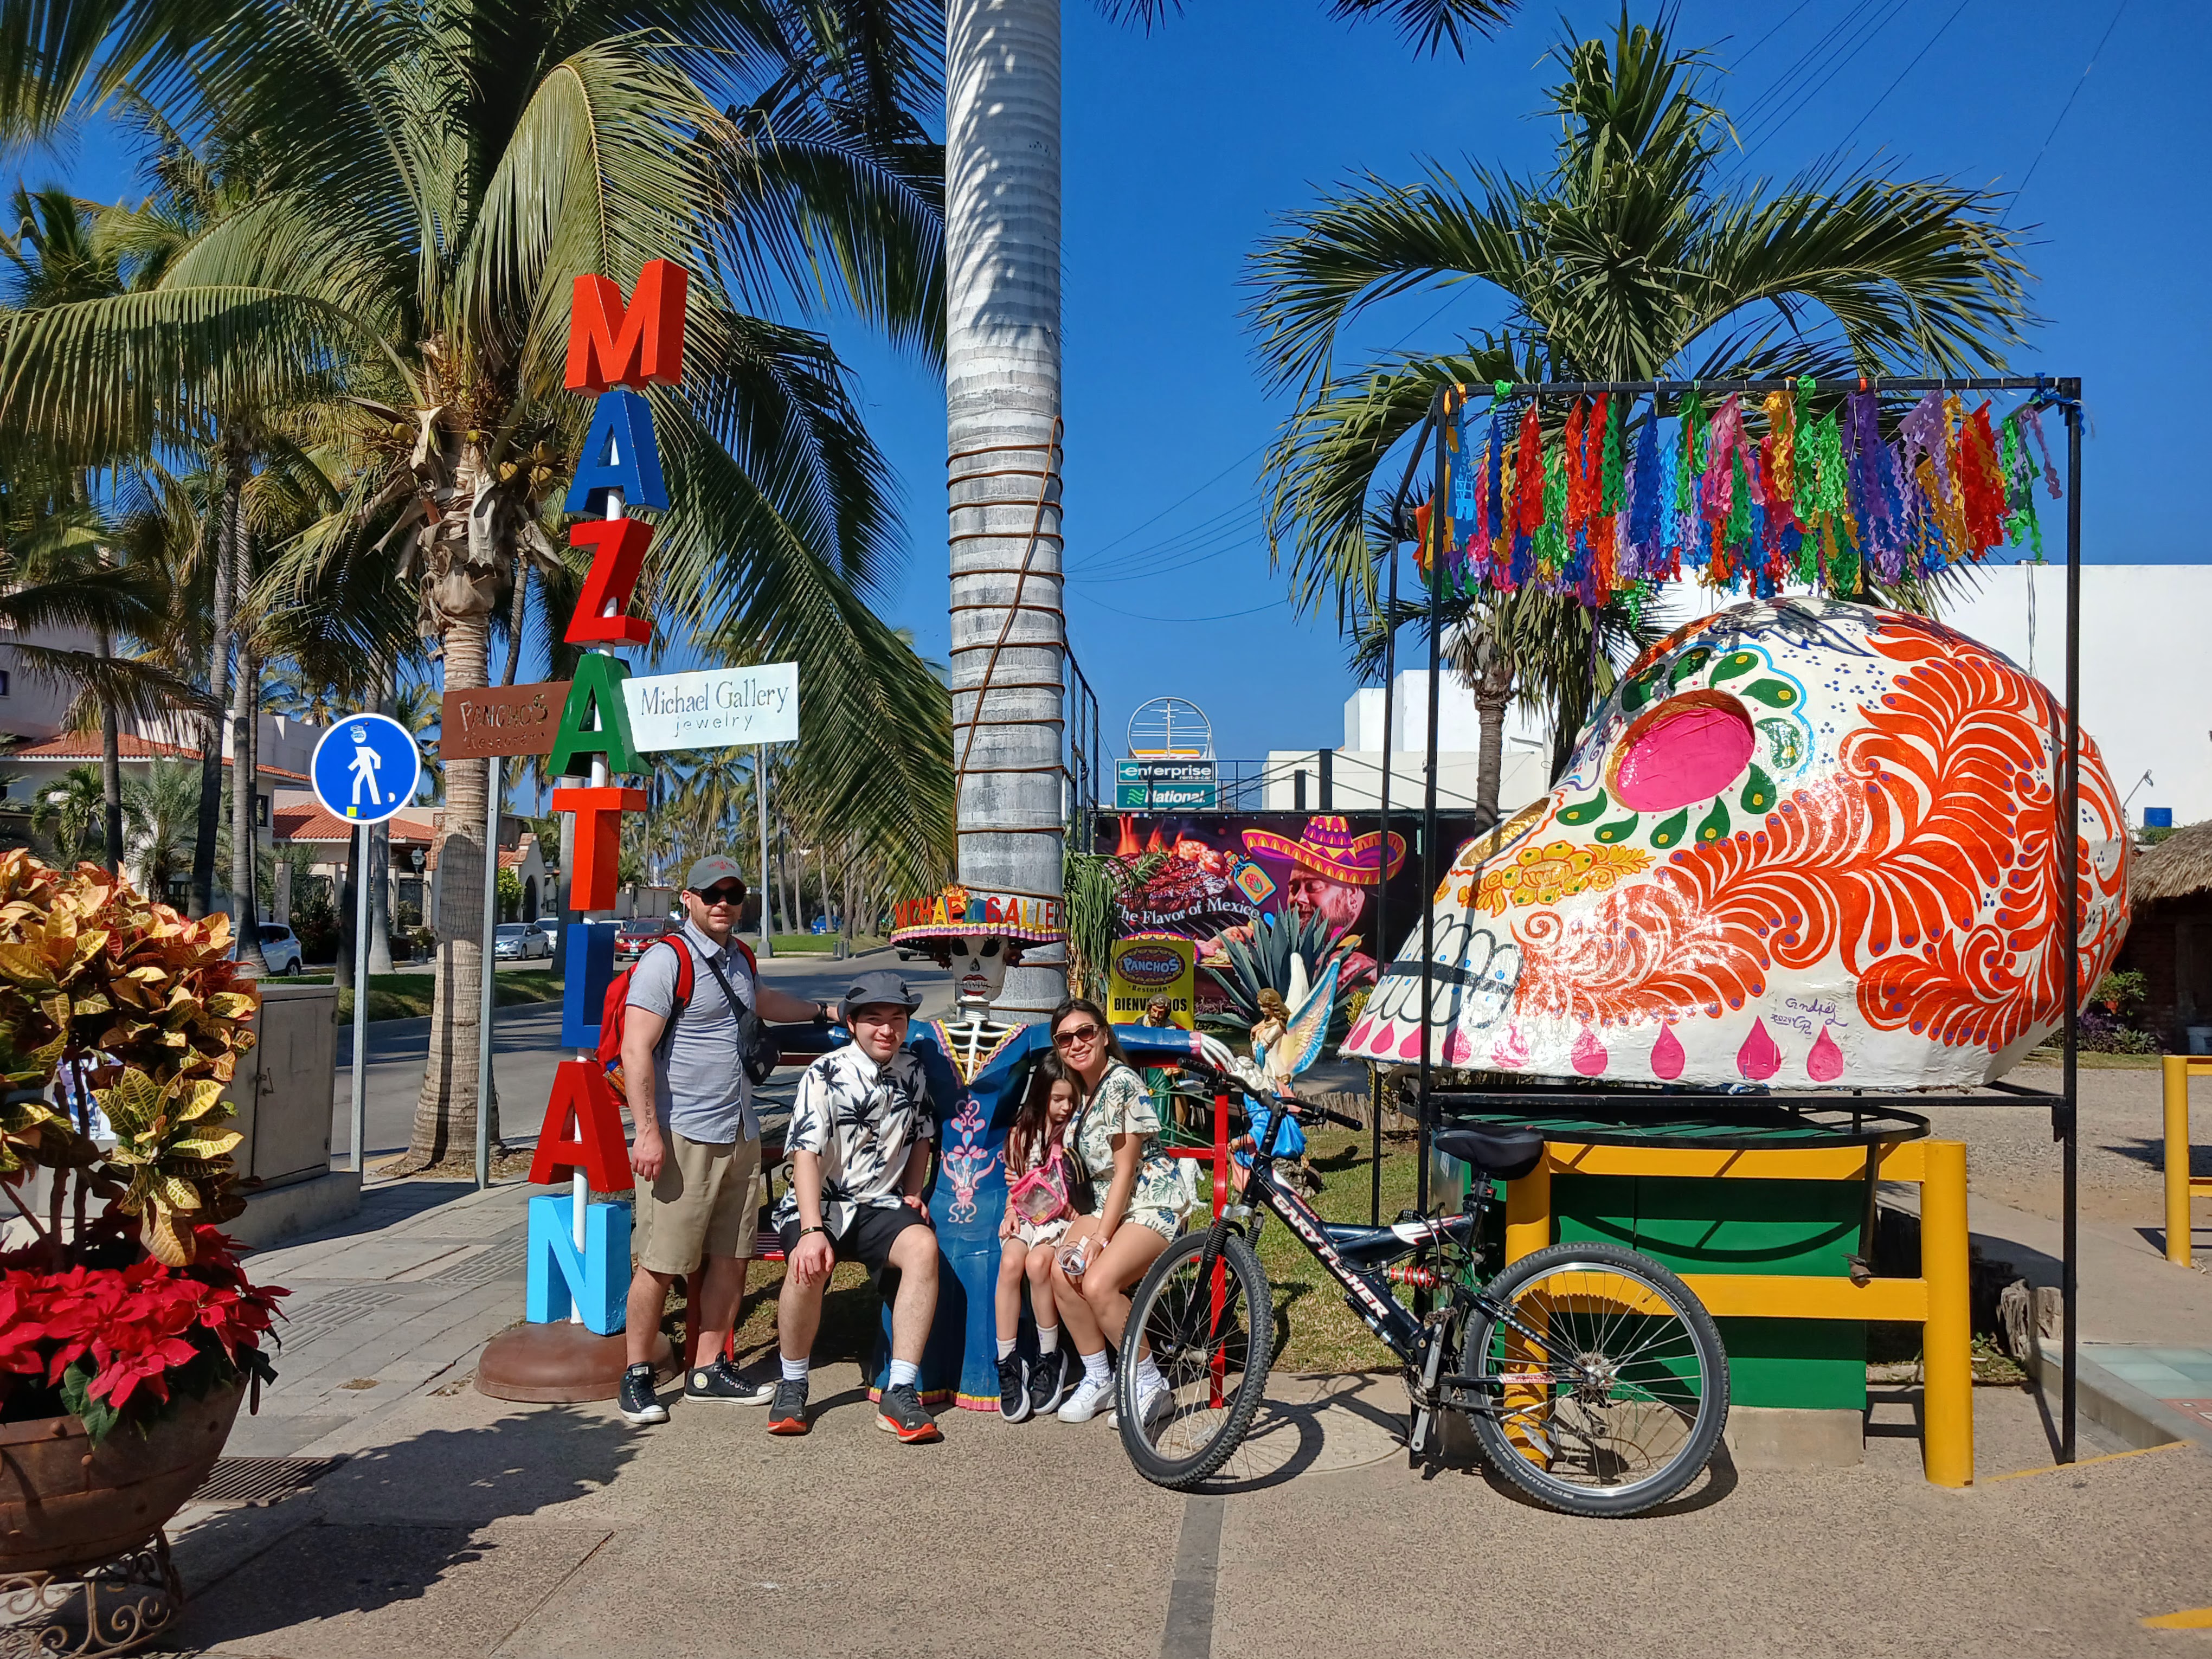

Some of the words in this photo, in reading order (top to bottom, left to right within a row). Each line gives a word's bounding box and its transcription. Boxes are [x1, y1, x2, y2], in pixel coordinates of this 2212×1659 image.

[642, 683, 709, 715] Michael
[716, 678, 789, 713] Gallery
[674, 711, 753, 737] jewelry
[526, 258, 687, 1336] MAZATLAN
[1142, 909, 1186, 924] Flavor
[1188, 901, 1202, 915] of
[1207, 897, 1261, 919] Mexico
[1123, 957, 1180, 973] PANCHOS
[1272, 1191, 1323, 1243] GARY
[1318, 1242, 1390, 1320] FISHER
